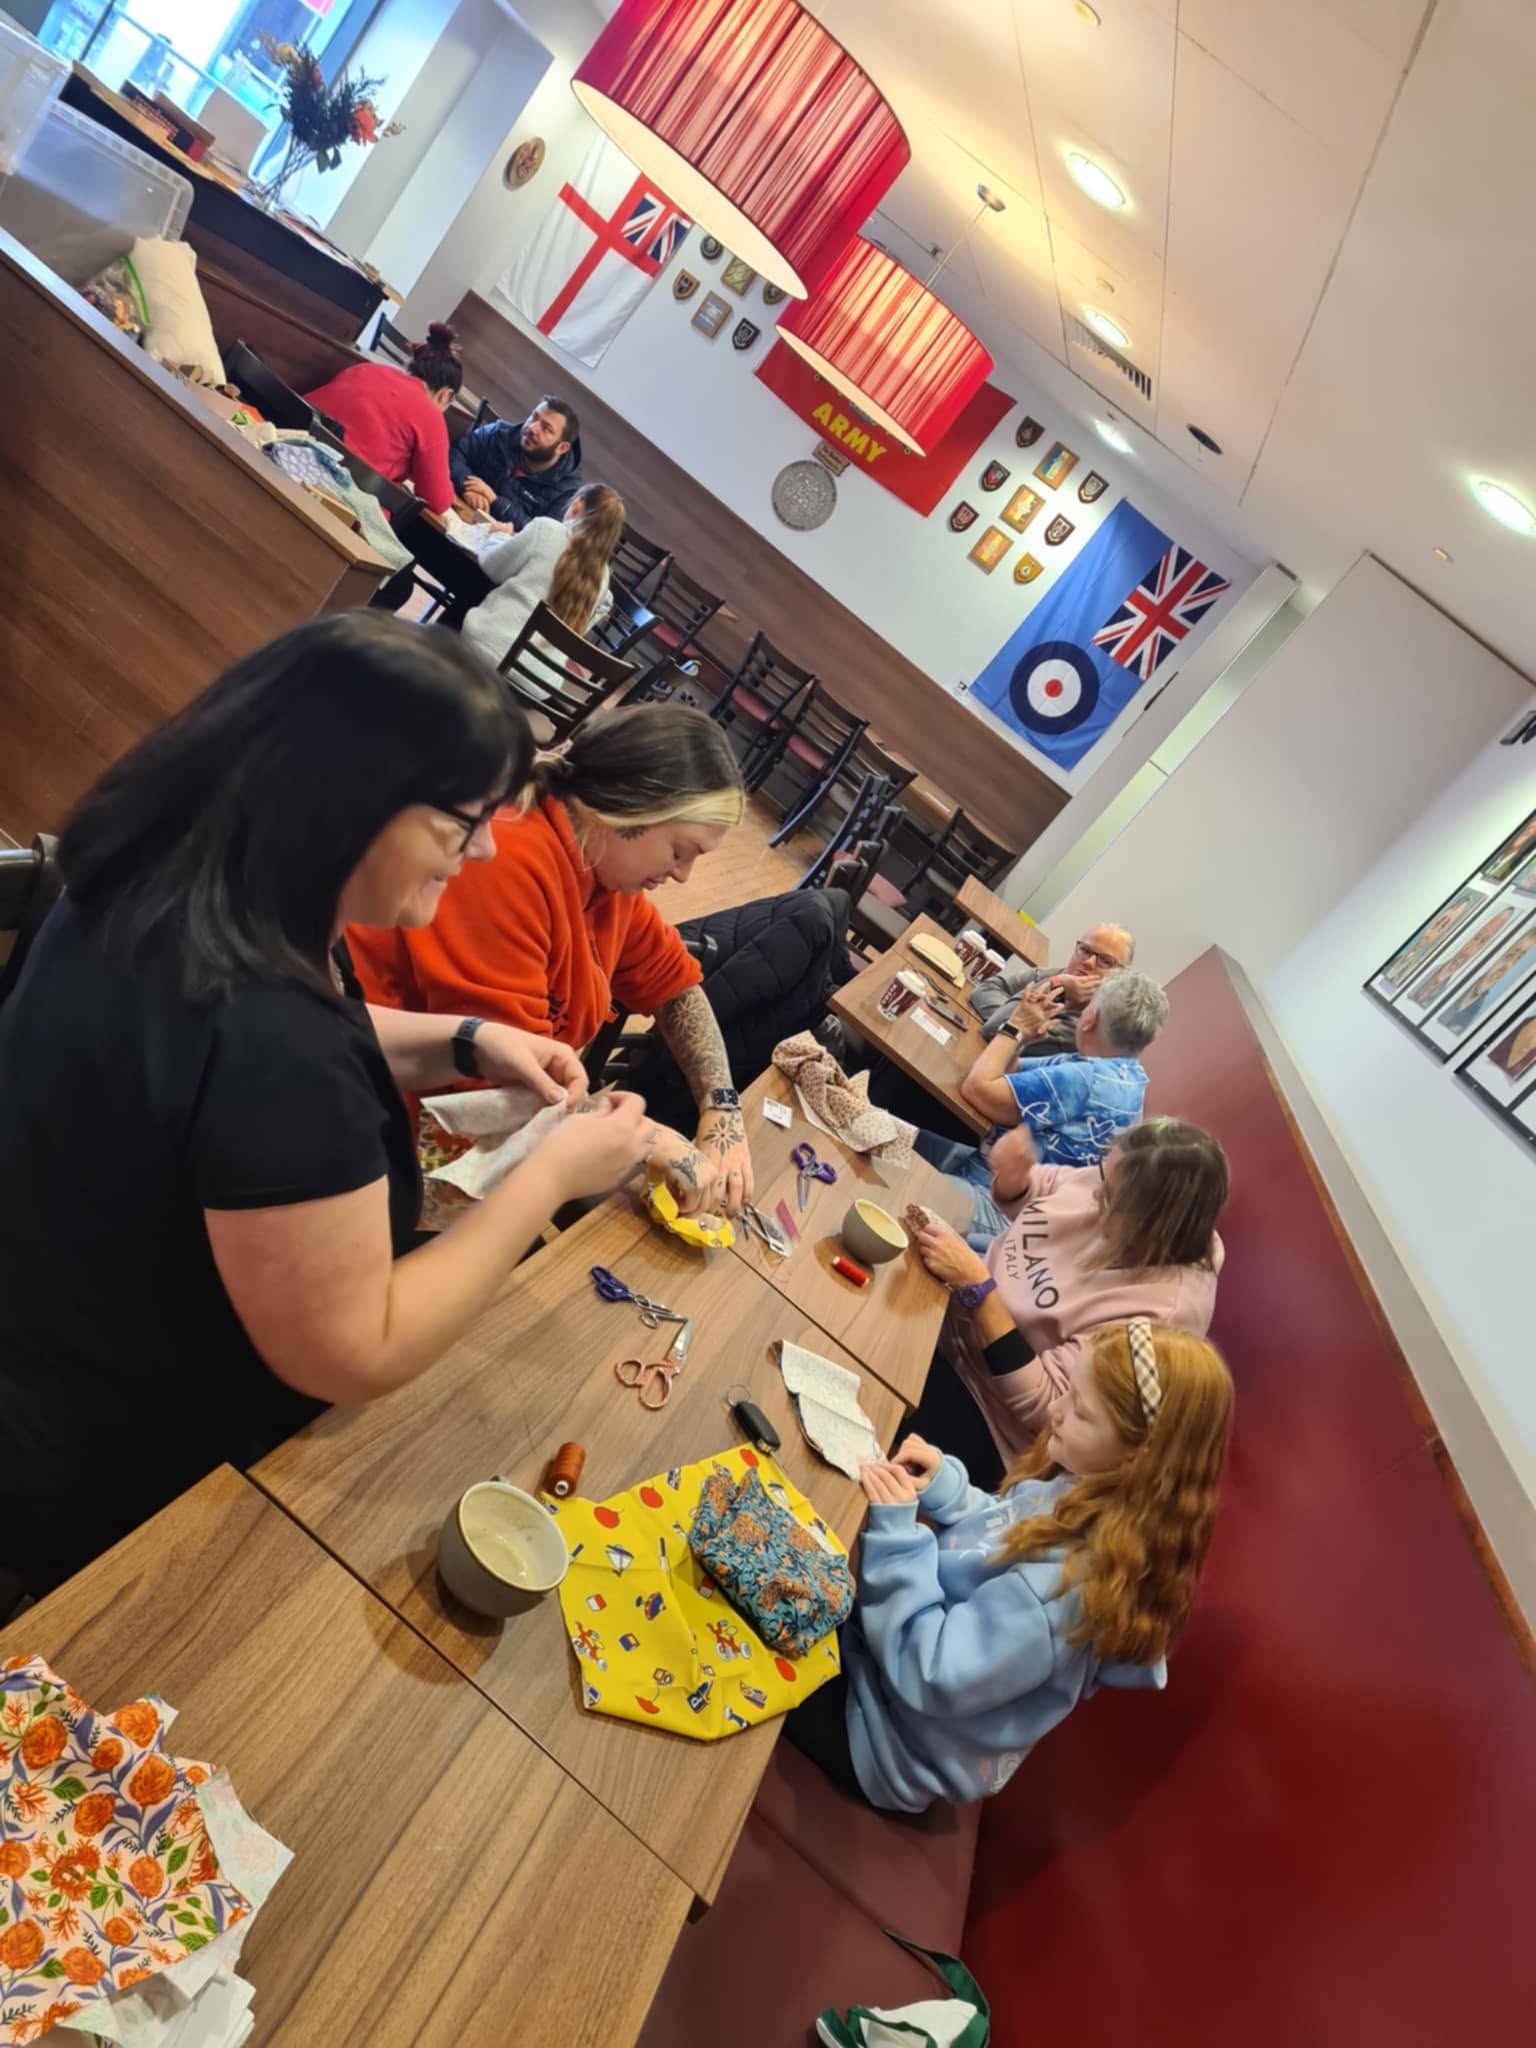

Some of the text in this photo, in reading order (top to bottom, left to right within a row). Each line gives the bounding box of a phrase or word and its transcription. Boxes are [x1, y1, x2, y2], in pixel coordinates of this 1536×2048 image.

[812, 402, 887, 463] ARMY
[1005, 1239, 1020, 1280] ITALY
[1022, 1200, 1059, 1309] MILANO
